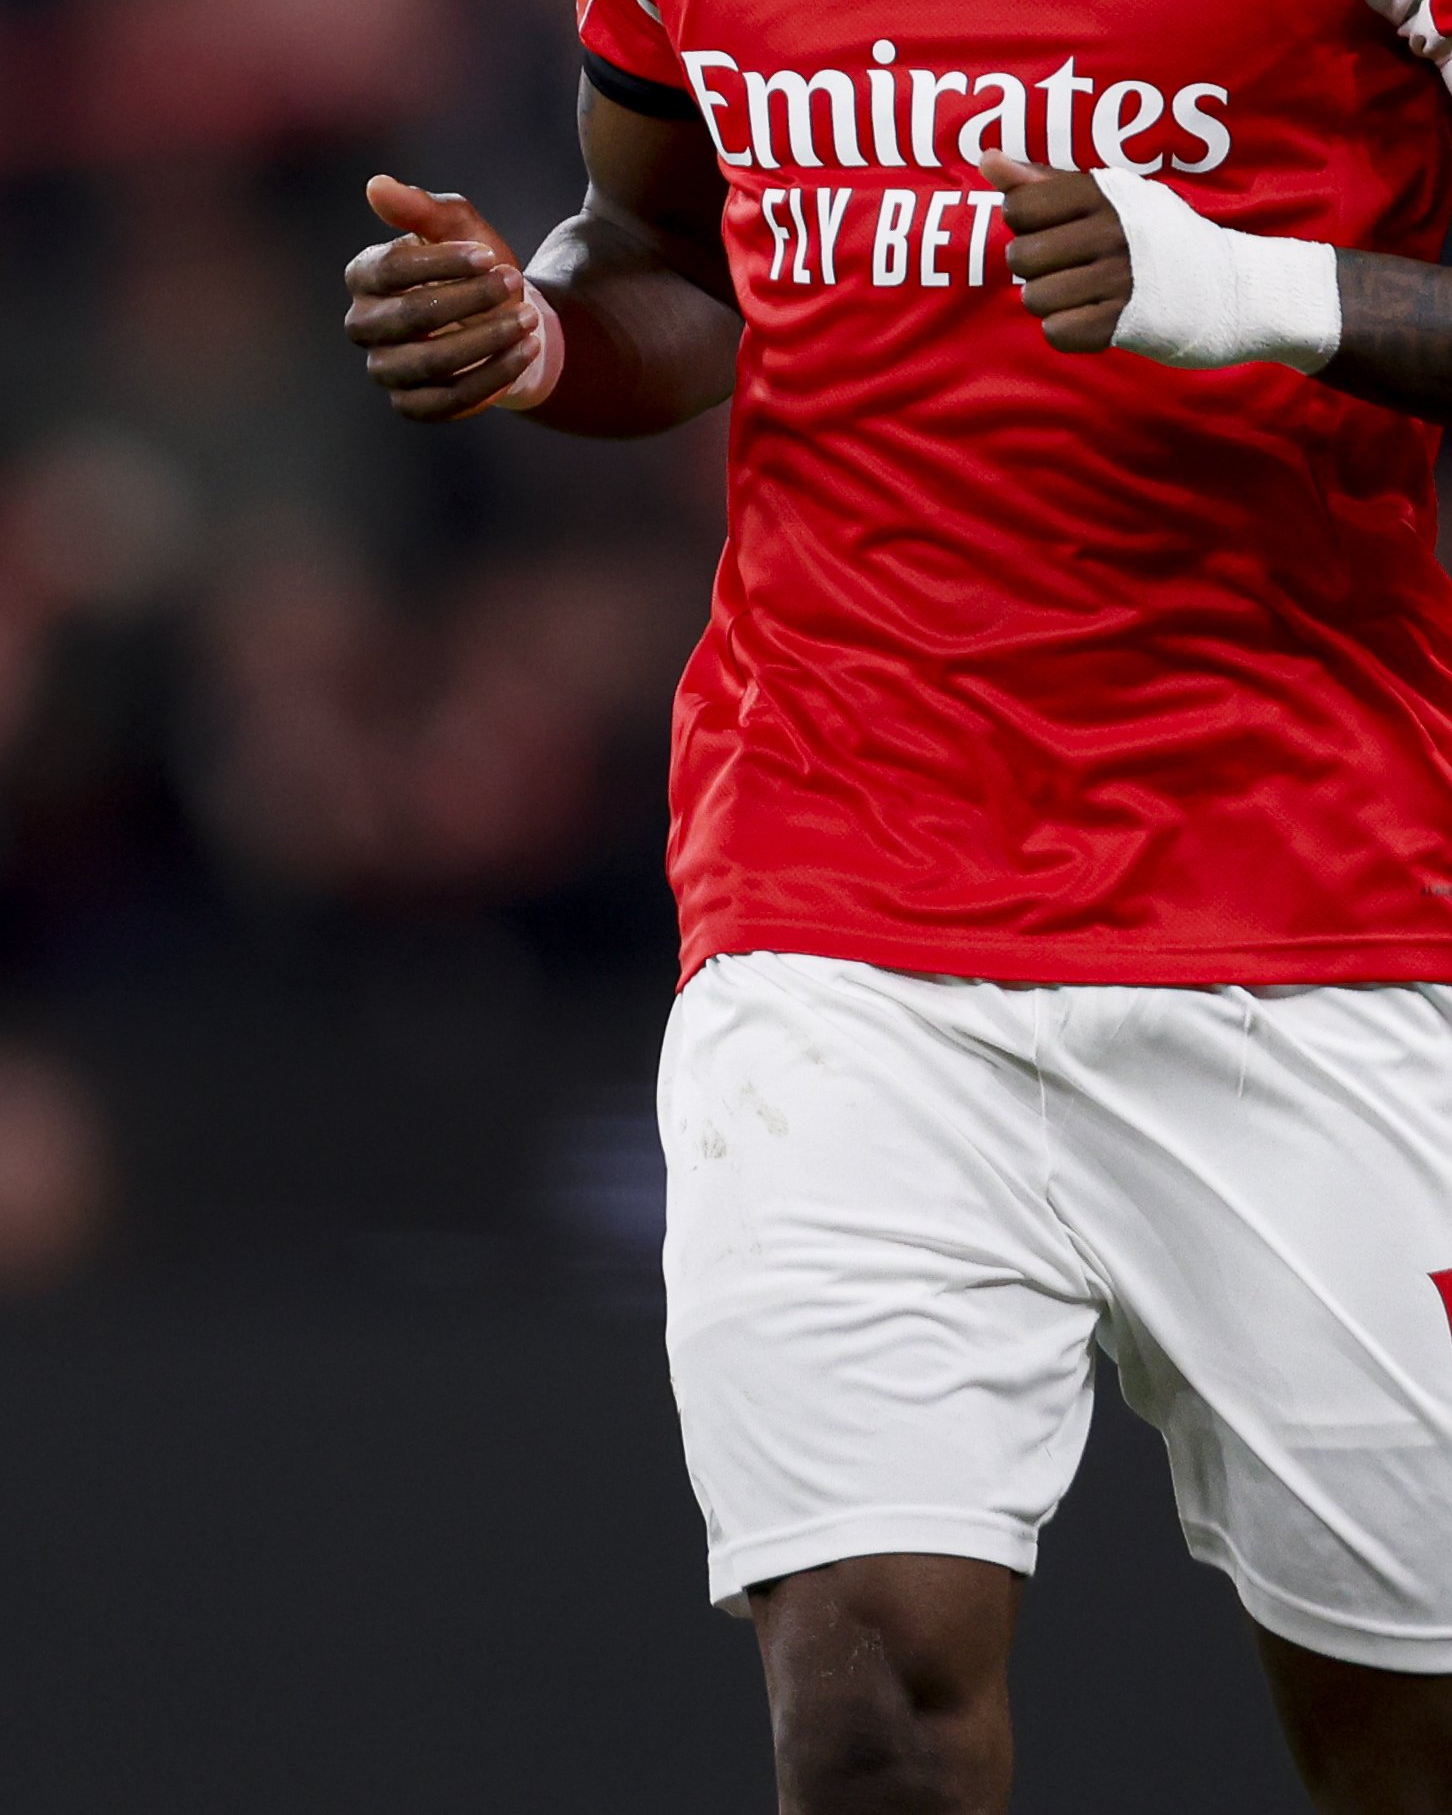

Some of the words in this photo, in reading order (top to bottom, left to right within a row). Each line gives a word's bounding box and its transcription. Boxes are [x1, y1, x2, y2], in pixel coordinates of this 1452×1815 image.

[680, 39, 1231, 173] Emirates
[761, 187, 853, 285] FLY
[872, 188, 1027, 287] BET
